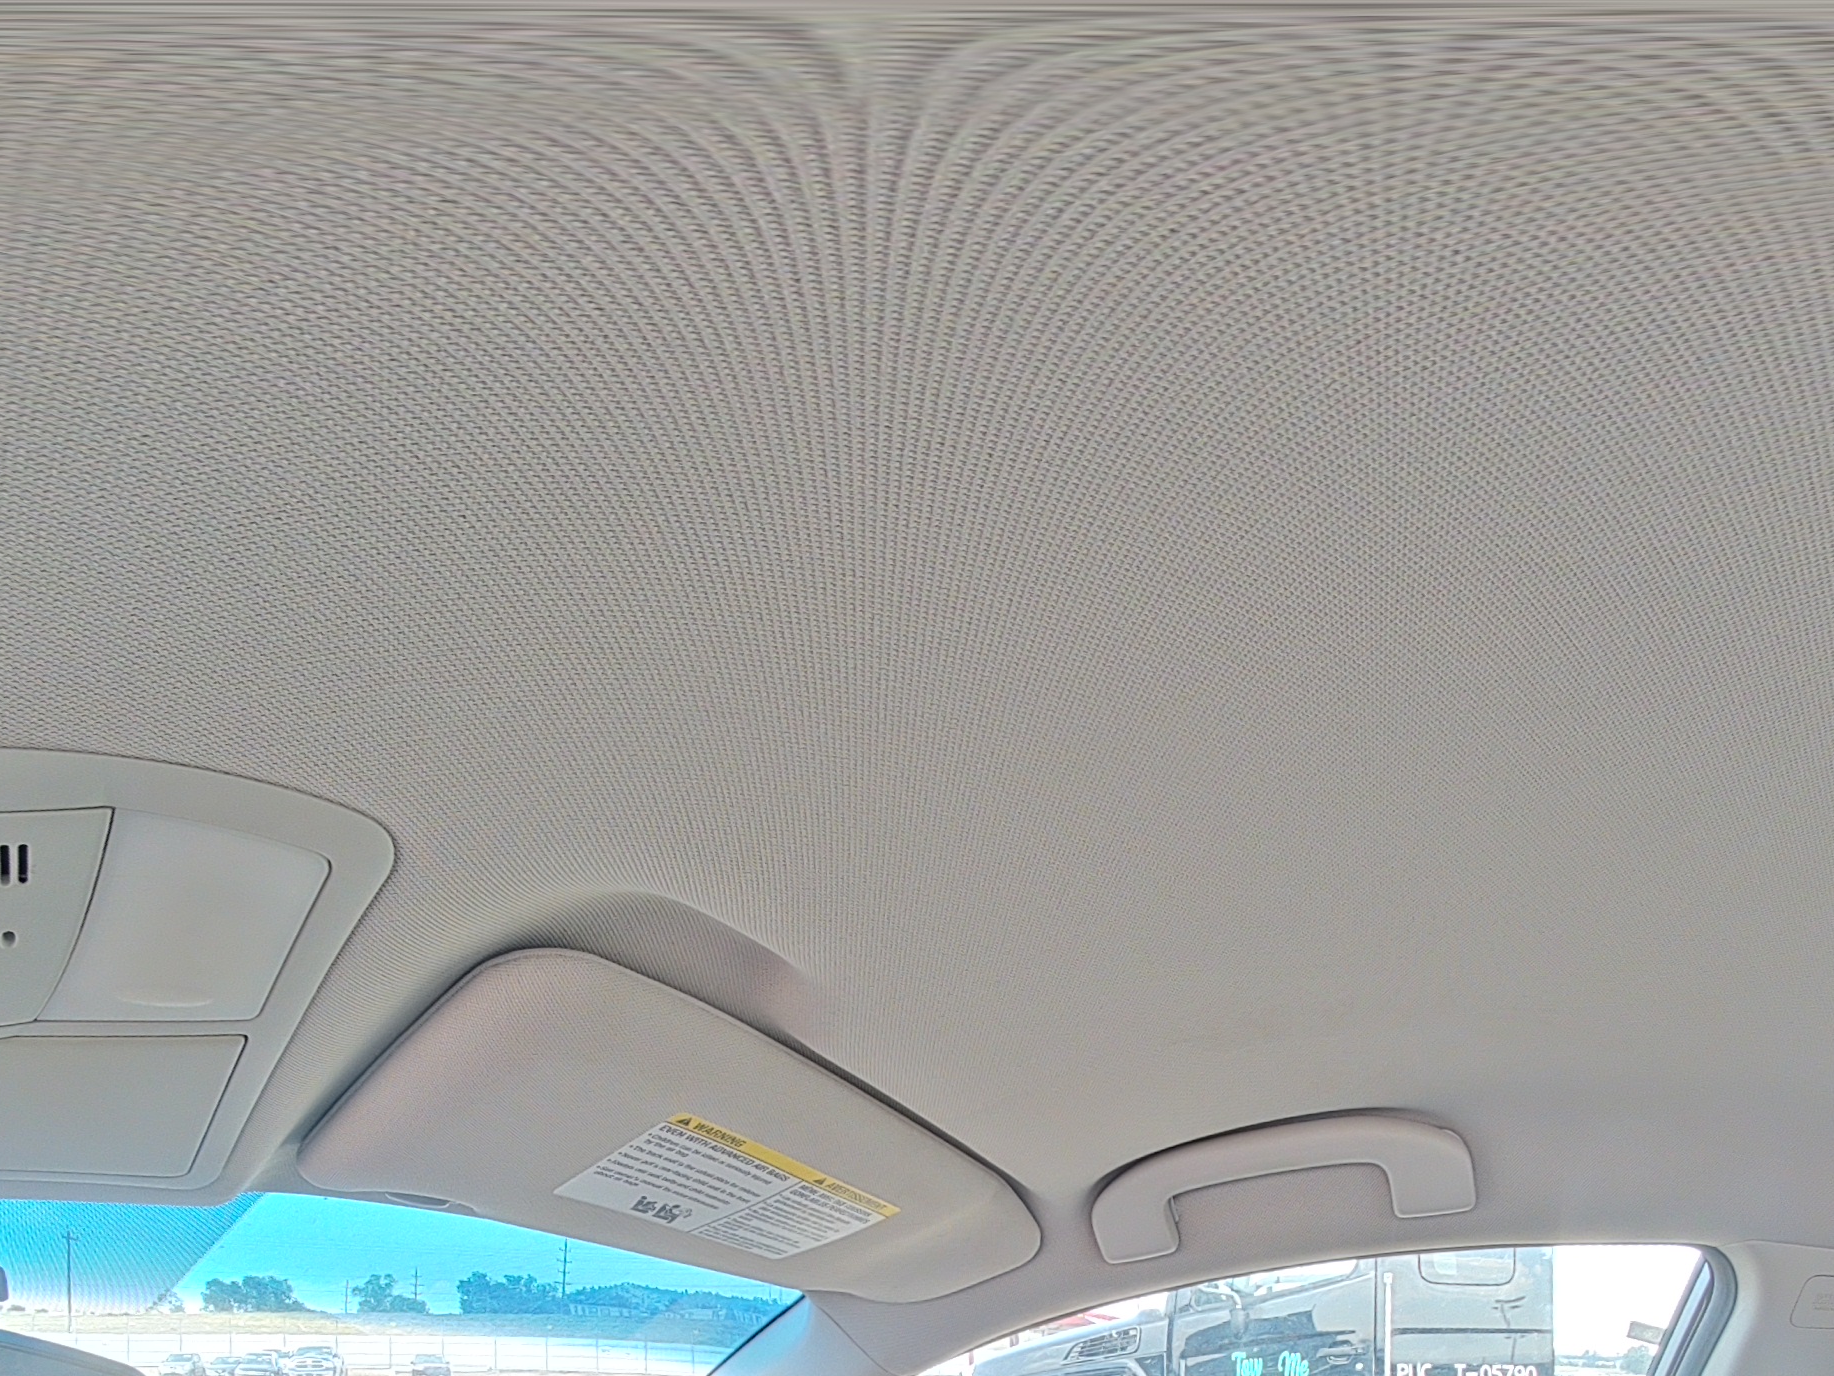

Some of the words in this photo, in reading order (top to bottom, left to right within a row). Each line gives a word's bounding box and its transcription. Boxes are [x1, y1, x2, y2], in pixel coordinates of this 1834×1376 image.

[659, 1125, 684, 1138] EVEN
[686, 1134, 708, 1147] WITH
[710, 1142, 754, 1166] ADVANCED
[749, 1162, 770, 1172] AIR
[763, 1169, 791, 1181] BAGS
[693, 1122, 746, 1148] WARNING
